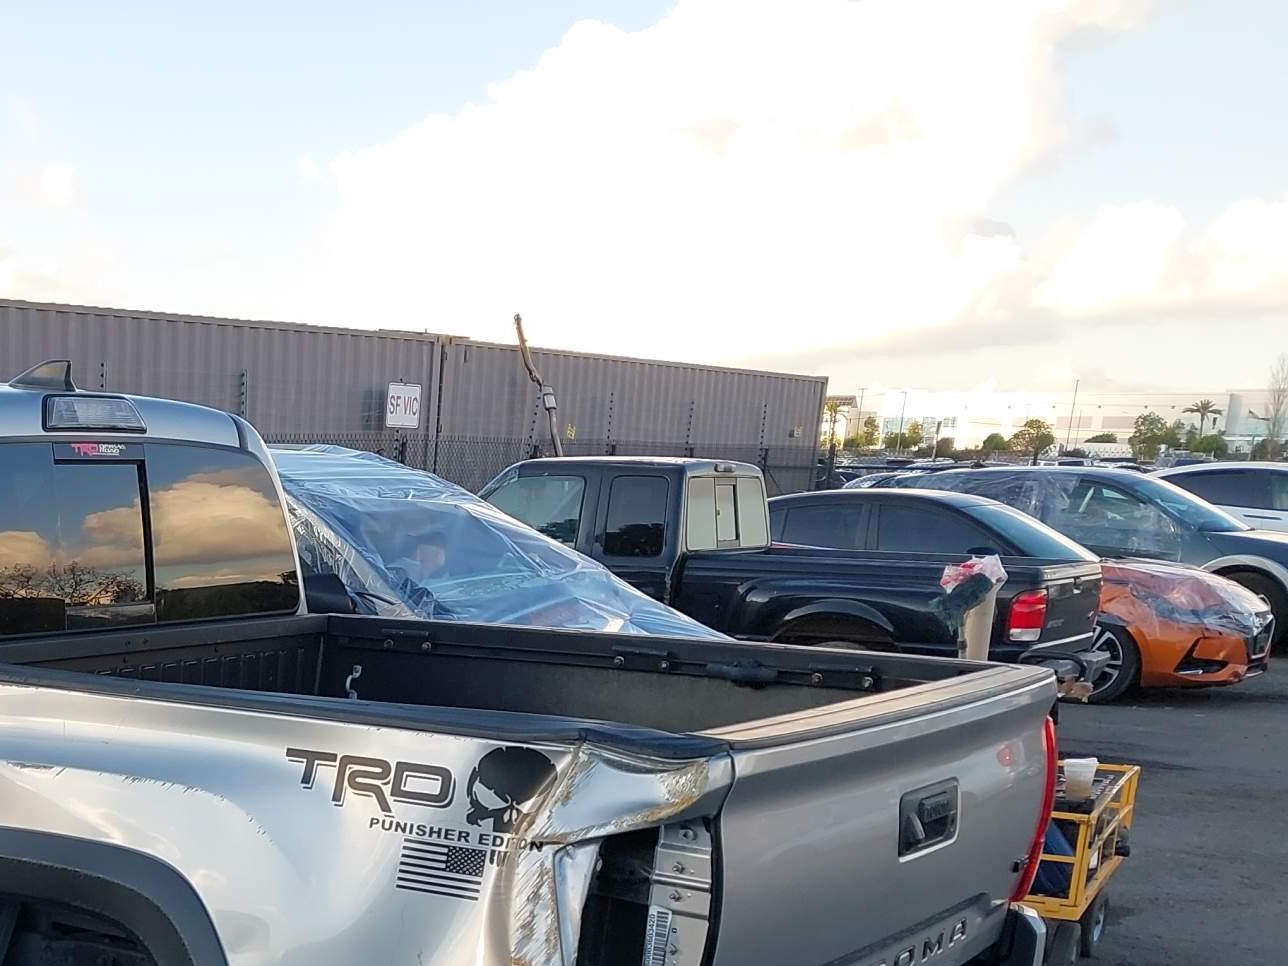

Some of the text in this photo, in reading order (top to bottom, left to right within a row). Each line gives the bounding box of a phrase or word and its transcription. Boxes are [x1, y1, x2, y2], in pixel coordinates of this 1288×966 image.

[389, 395, 401, 415] SF
[286, 747, 456, 817] TRD
[369, 817, 470, 843] PUNISHER
